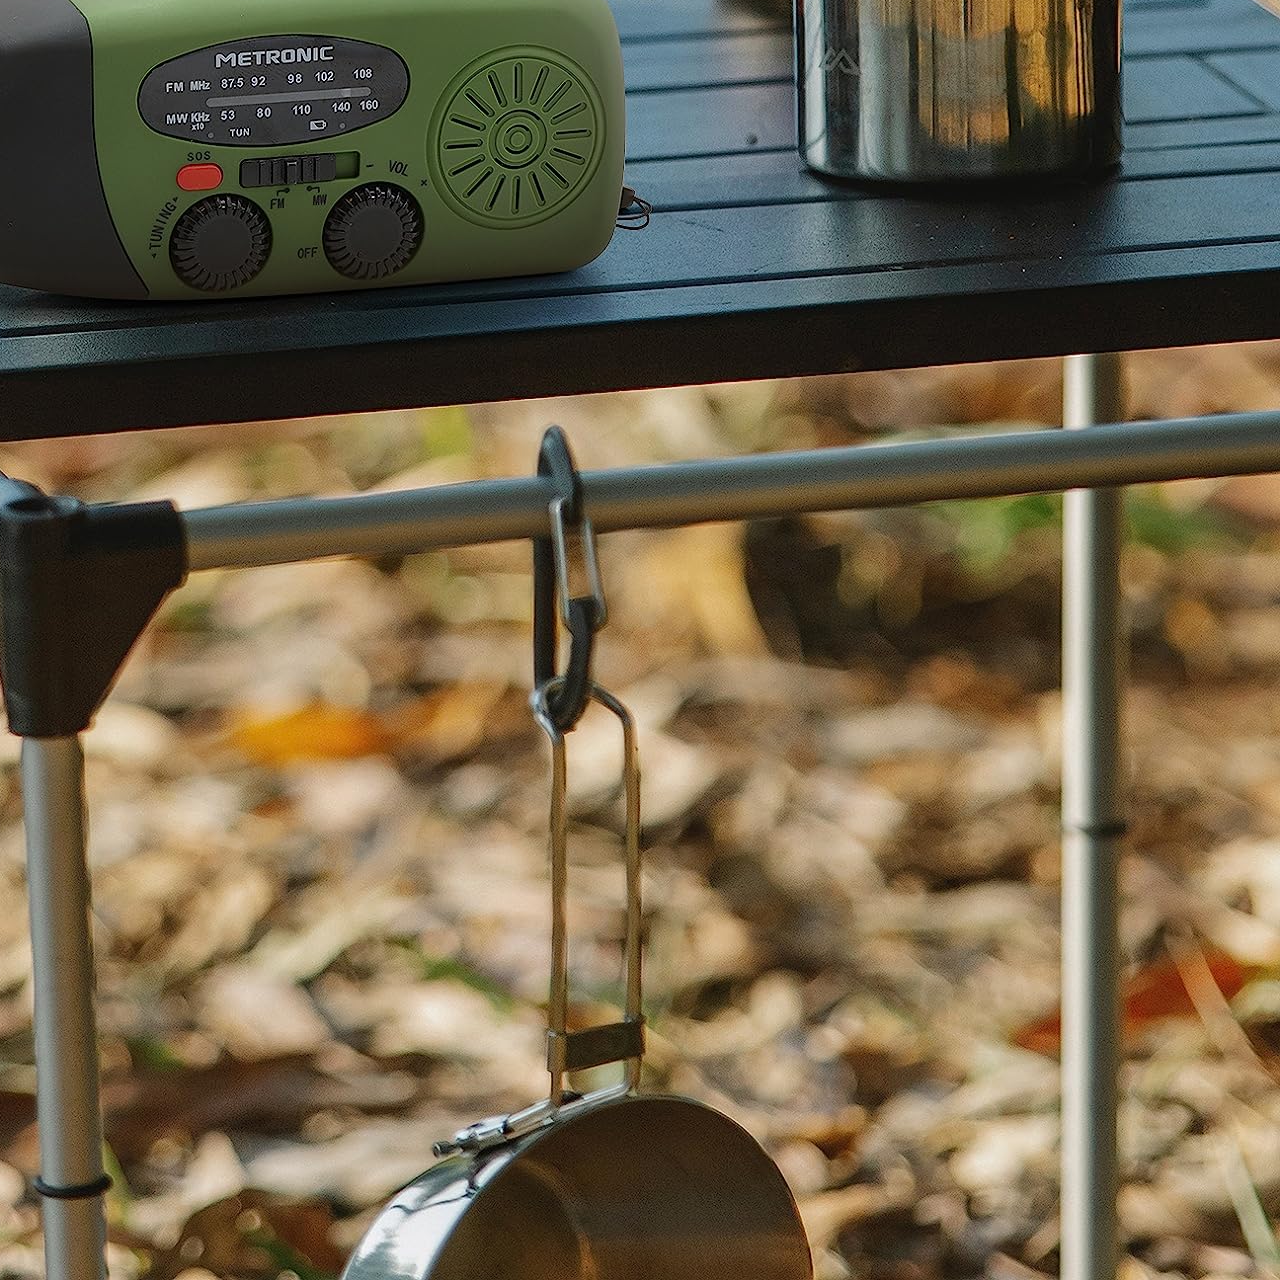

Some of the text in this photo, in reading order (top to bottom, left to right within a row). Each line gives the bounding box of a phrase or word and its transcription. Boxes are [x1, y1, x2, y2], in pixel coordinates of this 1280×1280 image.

[215, 46, 334, 68] METRONIC
[166, 68, 372, 92] FM MHz 87.5 92 98 102 108
[166, 99, 379, 125] MW KHz 53 80 110 140 160
[229, 128, 250, 137] TUN
[187, 151, 211, 162] SOS
[389, 160, 408, 177] VOL
[270, 198, 285, 209] FM
[312, 195, 327, 206] MW
[149, 202, 177, 250] TUNING
[297, 247, 319, 259] OFF
